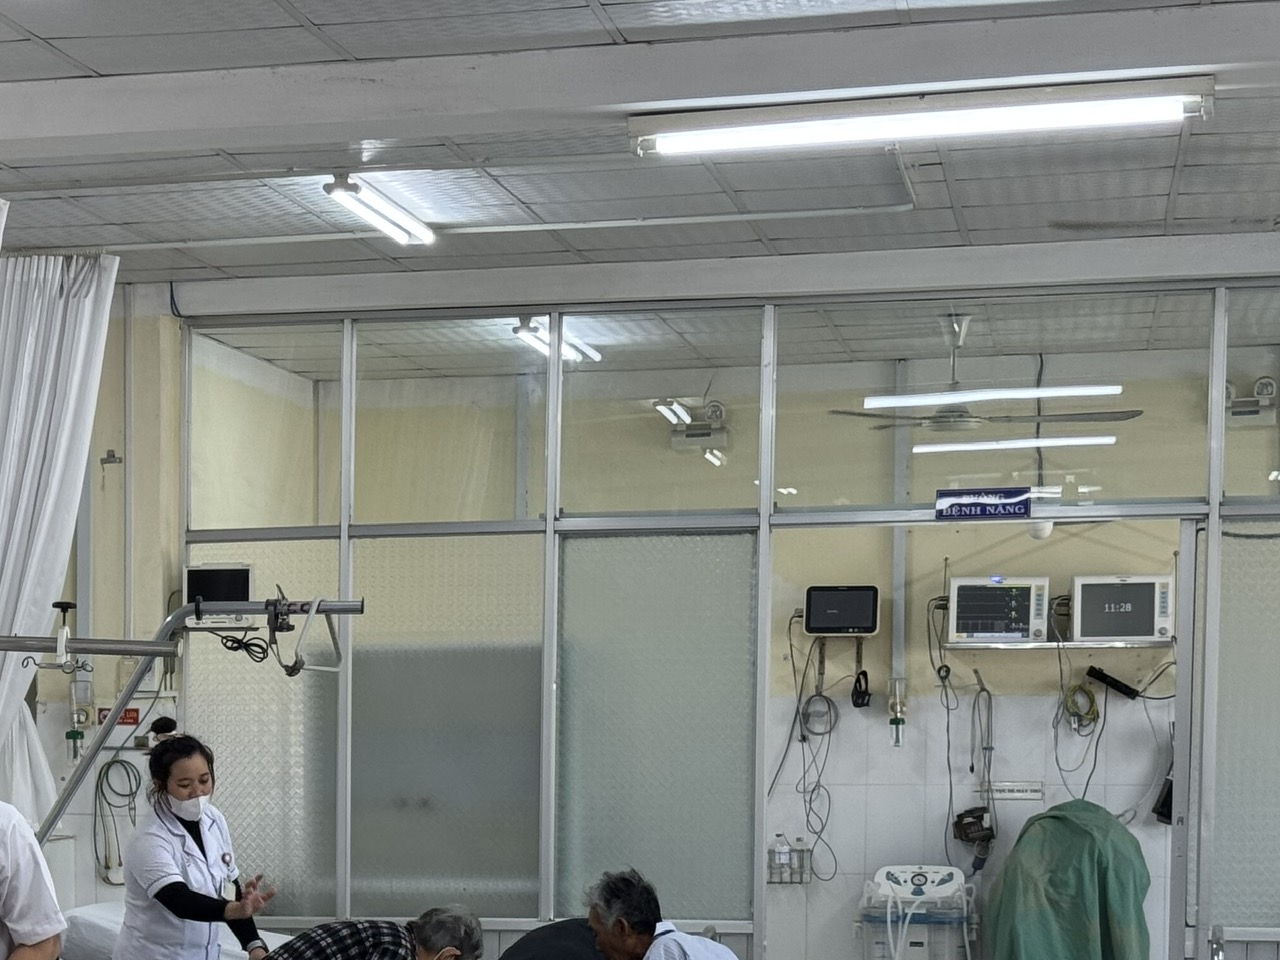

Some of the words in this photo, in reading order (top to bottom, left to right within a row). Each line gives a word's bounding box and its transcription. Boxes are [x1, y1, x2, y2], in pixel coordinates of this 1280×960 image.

[942, 505, 981, 517] BỆNH
[986, 504, 1025, 516] NẶNG
[1104, 603, 1132, 613] 11:28
